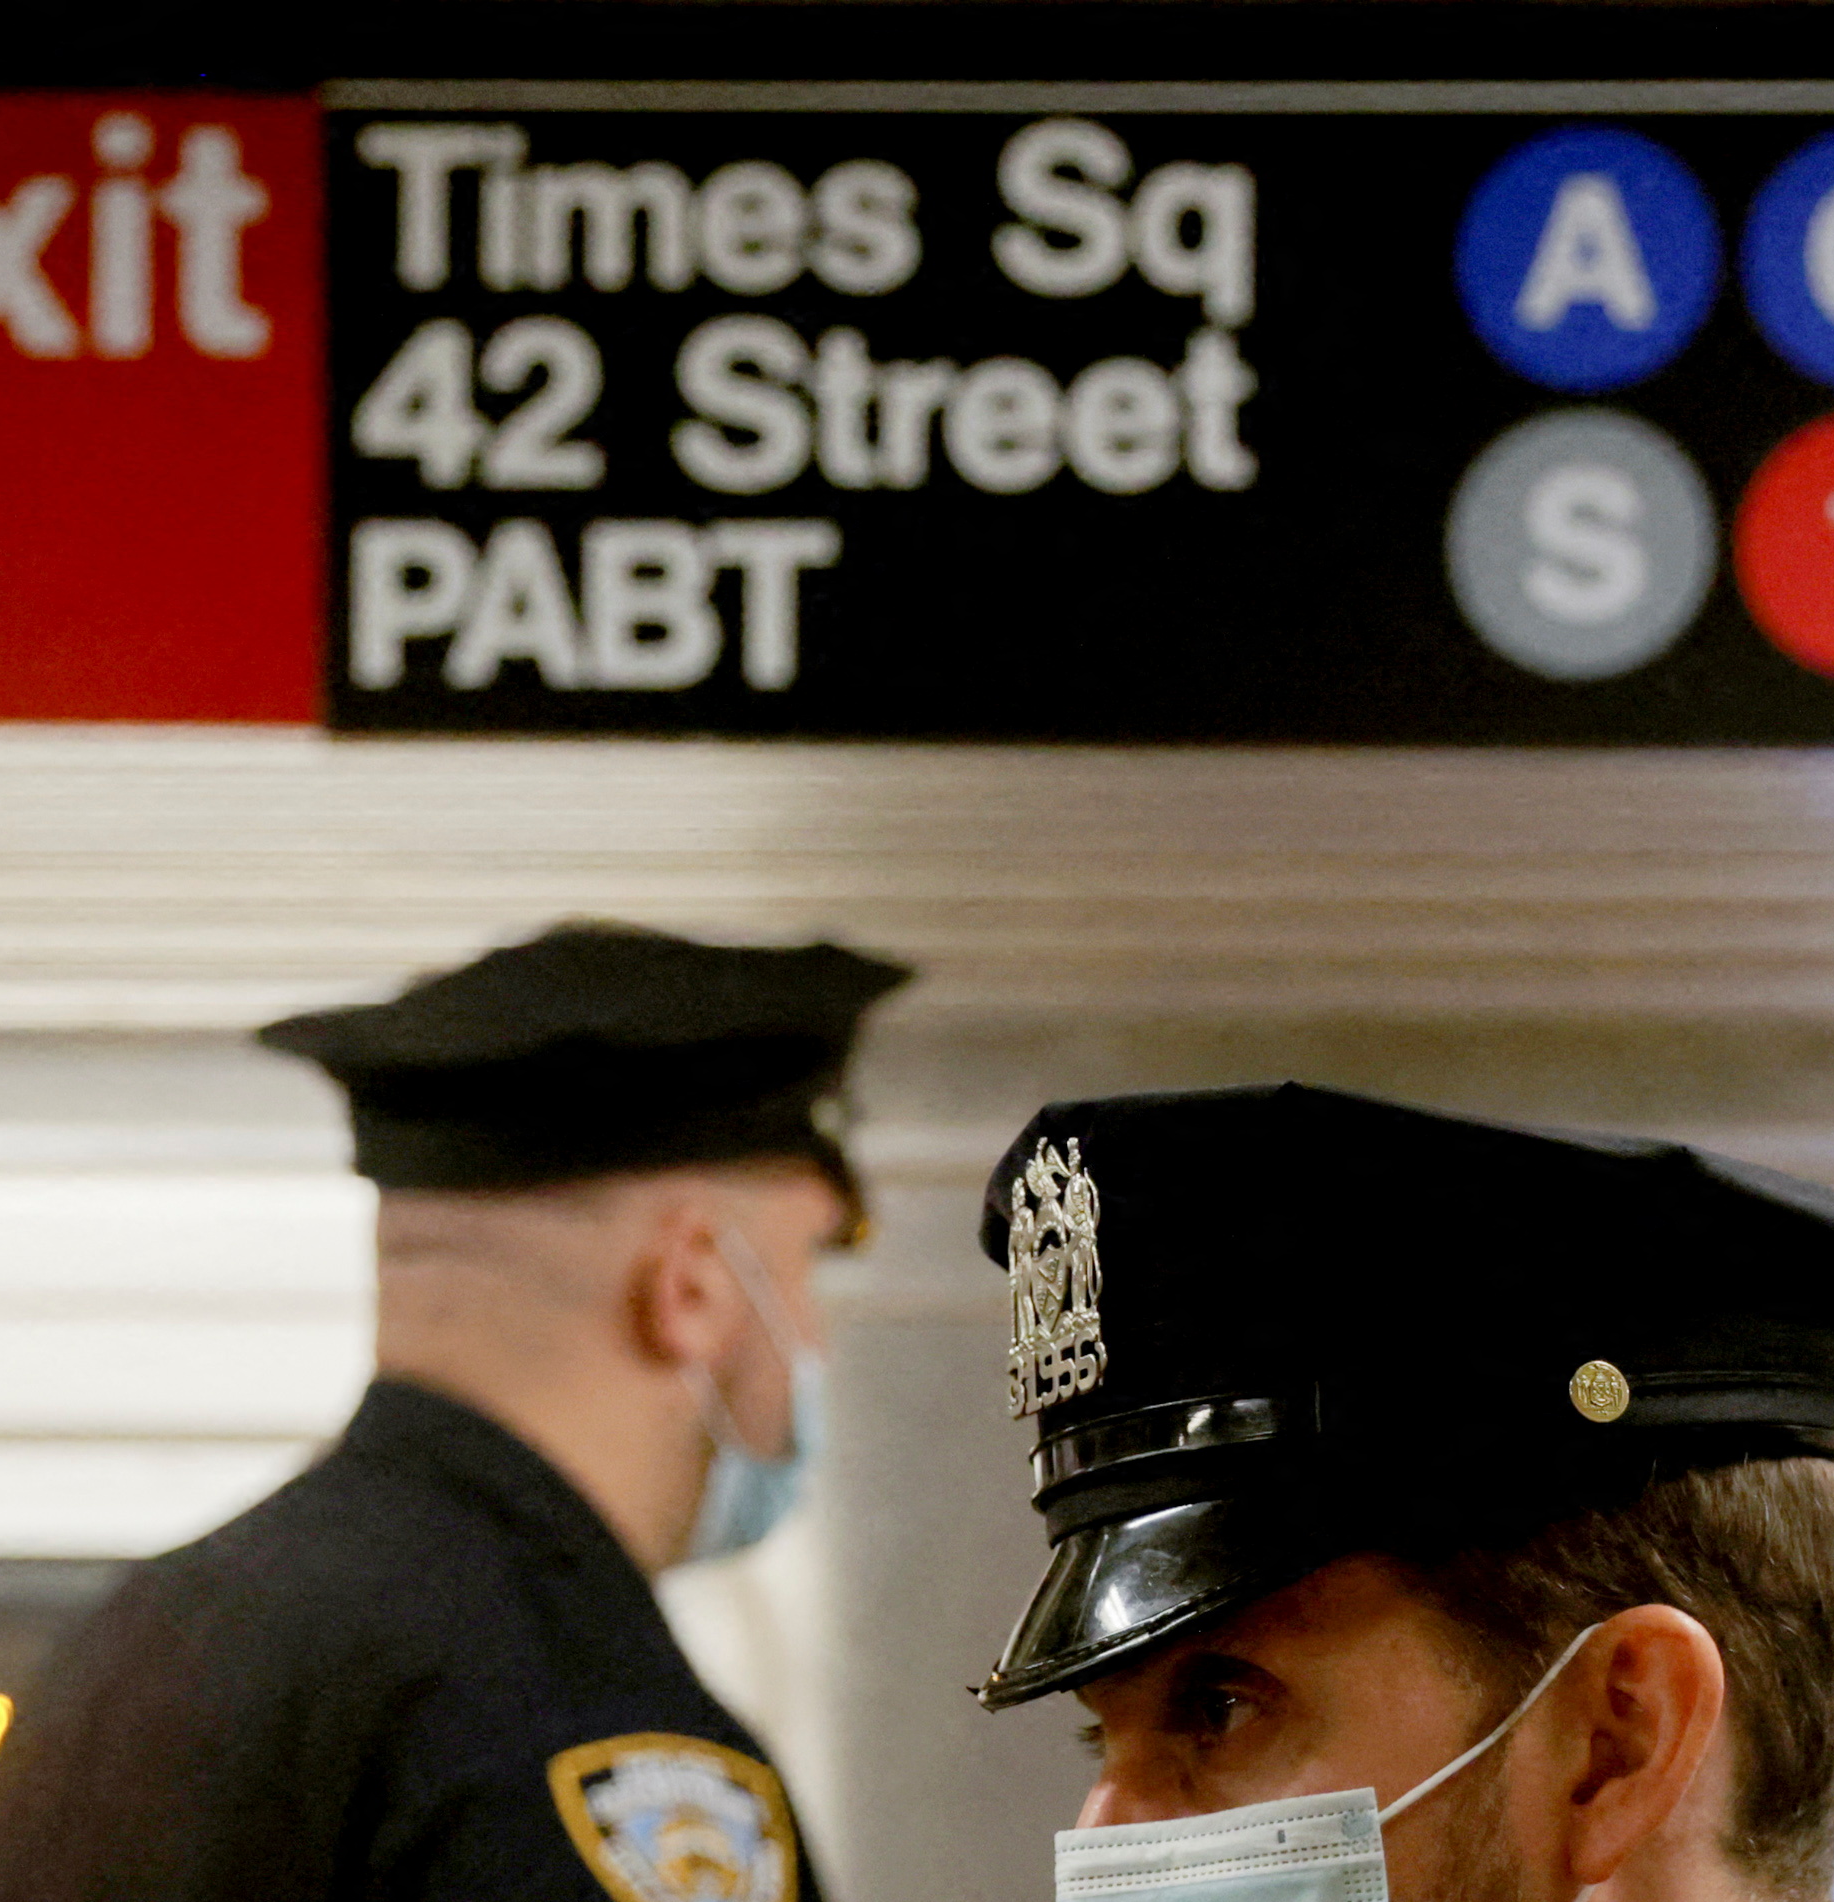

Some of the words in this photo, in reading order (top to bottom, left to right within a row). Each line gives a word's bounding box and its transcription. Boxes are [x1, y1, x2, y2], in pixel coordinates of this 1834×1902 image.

[355, 121, 924, 295] Times
[988, 116, 1260, 328] Sq
[1513, 171, 1658, 333] A
[350, 313, 606, 492] 42
[669, 311, 1260, 494] Street
[348, 517, 844, 691] PABT
[1521, 461, 1647, 624] S
[1007, 1328, 1098, 1420] 31956
